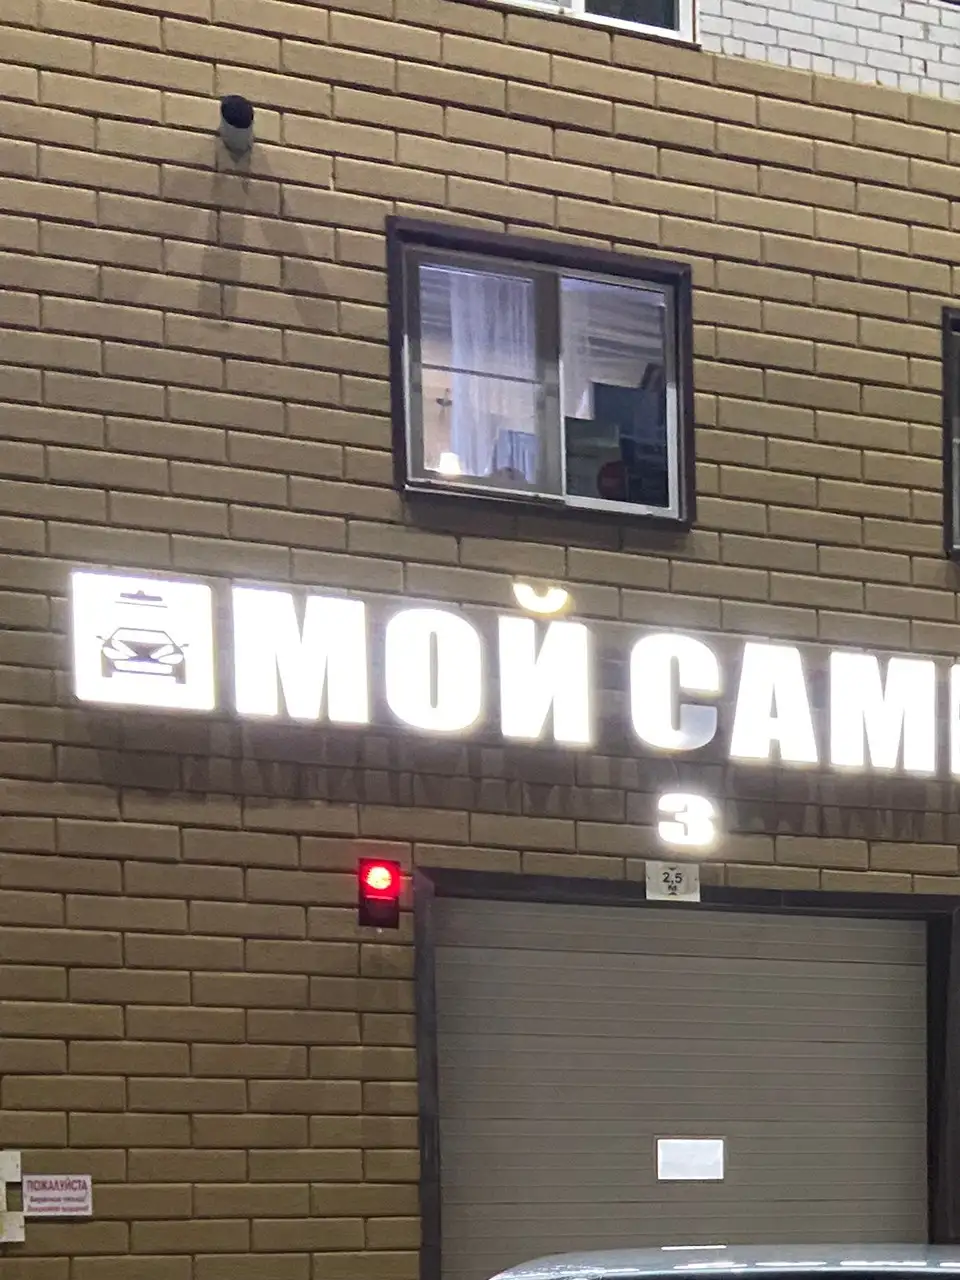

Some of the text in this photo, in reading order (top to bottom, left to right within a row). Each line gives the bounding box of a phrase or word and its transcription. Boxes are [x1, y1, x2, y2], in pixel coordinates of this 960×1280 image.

[232, 583, 937, 772] МОЙ САМ
[657, 792, 716, 846] 3
[662, 871, 683, 885] 2,5
